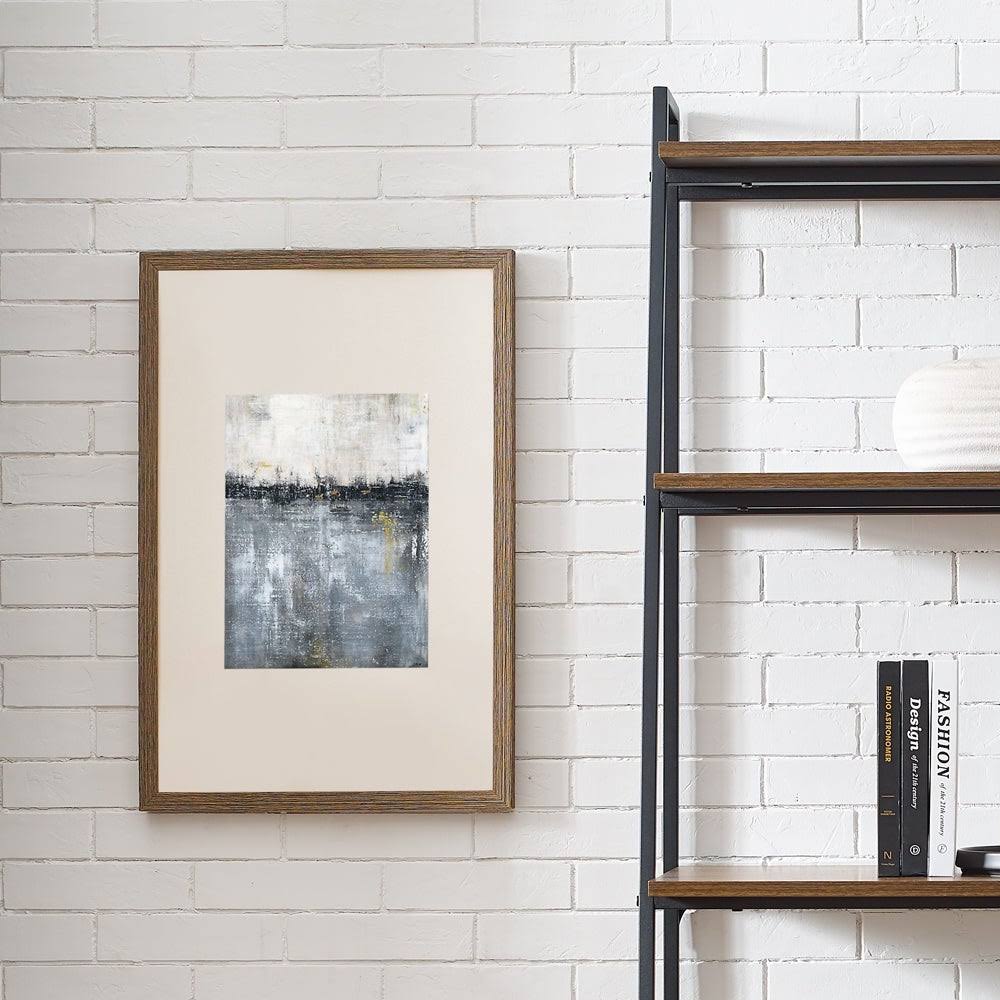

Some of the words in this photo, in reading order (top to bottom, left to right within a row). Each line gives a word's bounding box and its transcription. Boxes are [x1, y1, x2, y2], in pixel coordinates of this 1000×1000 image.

[907, 697, 922, 751] Design
[937, 689, 950, 779] FASHION
[911, 754, 918, 762] of
[939, 782, 946, 790] of
